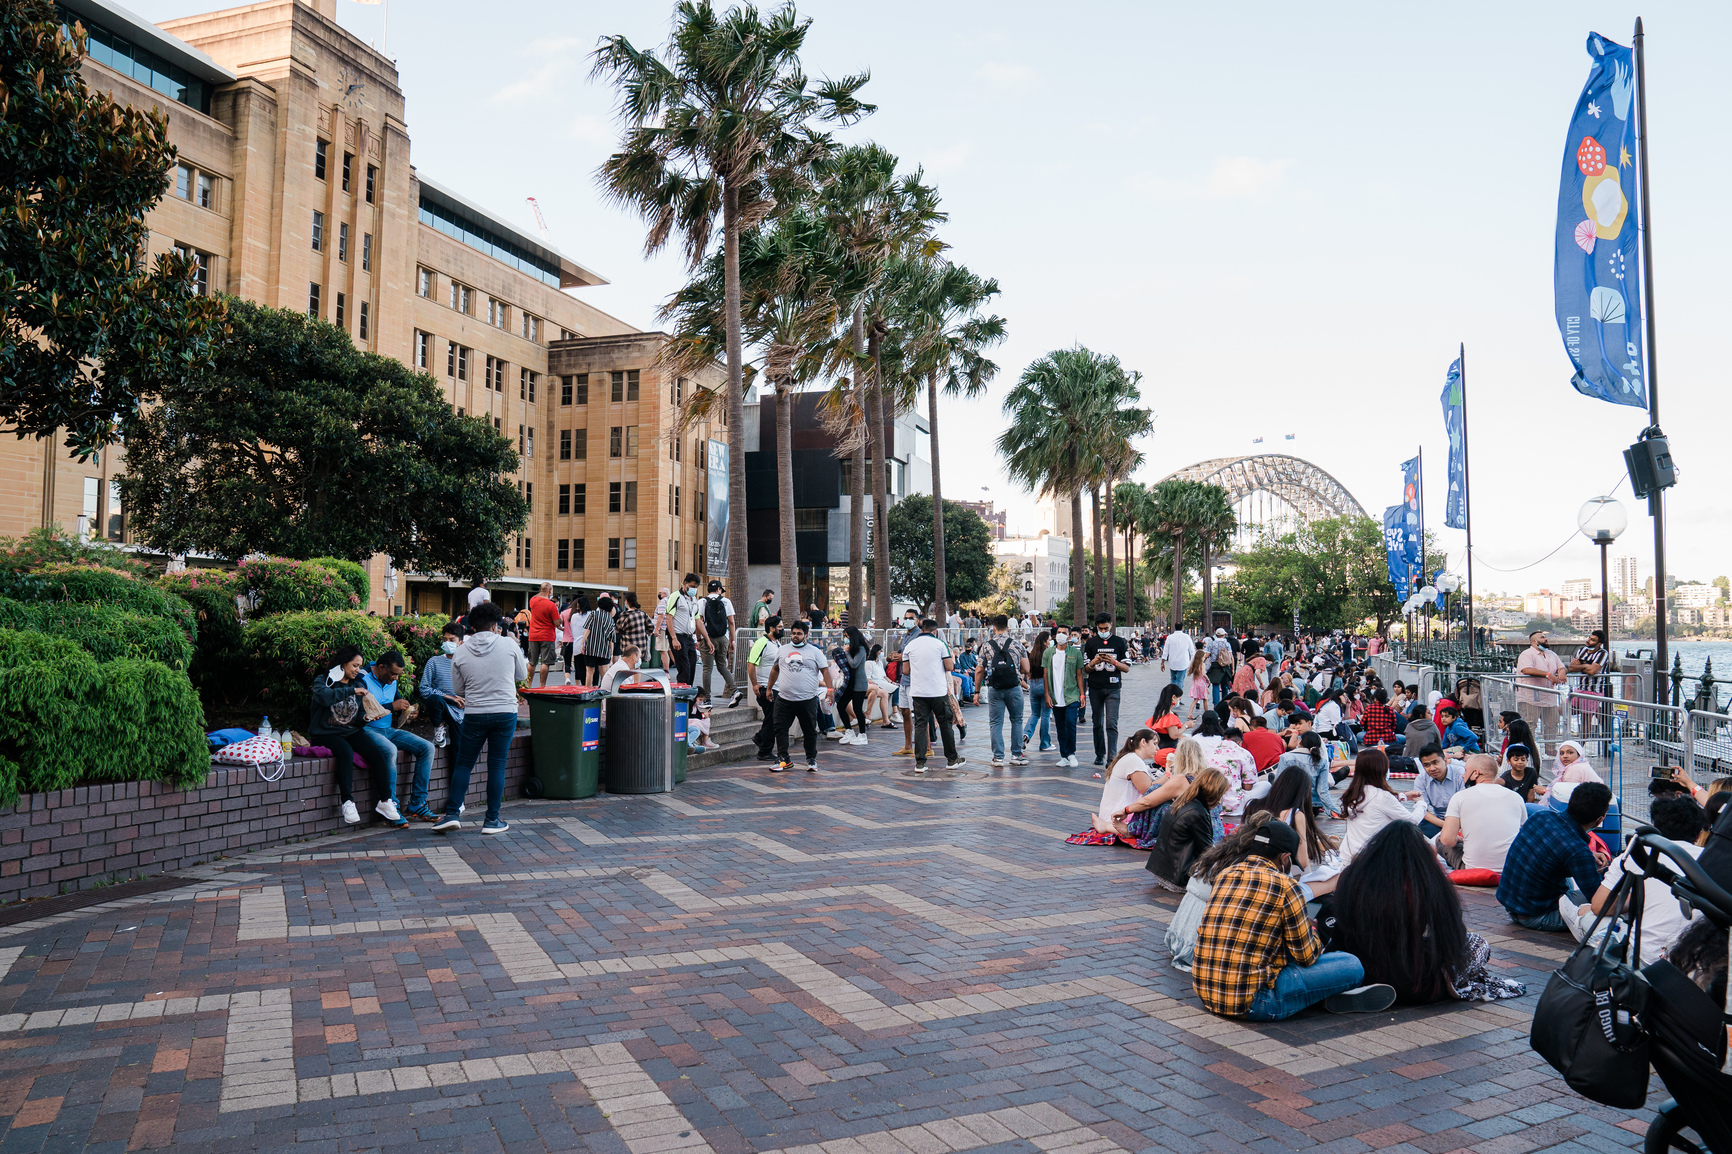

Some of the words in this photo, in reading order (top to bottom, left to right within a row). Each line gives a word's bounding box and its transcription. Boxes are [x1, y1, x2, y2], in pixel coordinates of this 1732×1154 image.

[708, 440, 726, 459] NEW
[708, 454, 726, 472] ERA
[864, 515, 874, 528] of
[1598, 1008, 1616, 1043] HUGO
